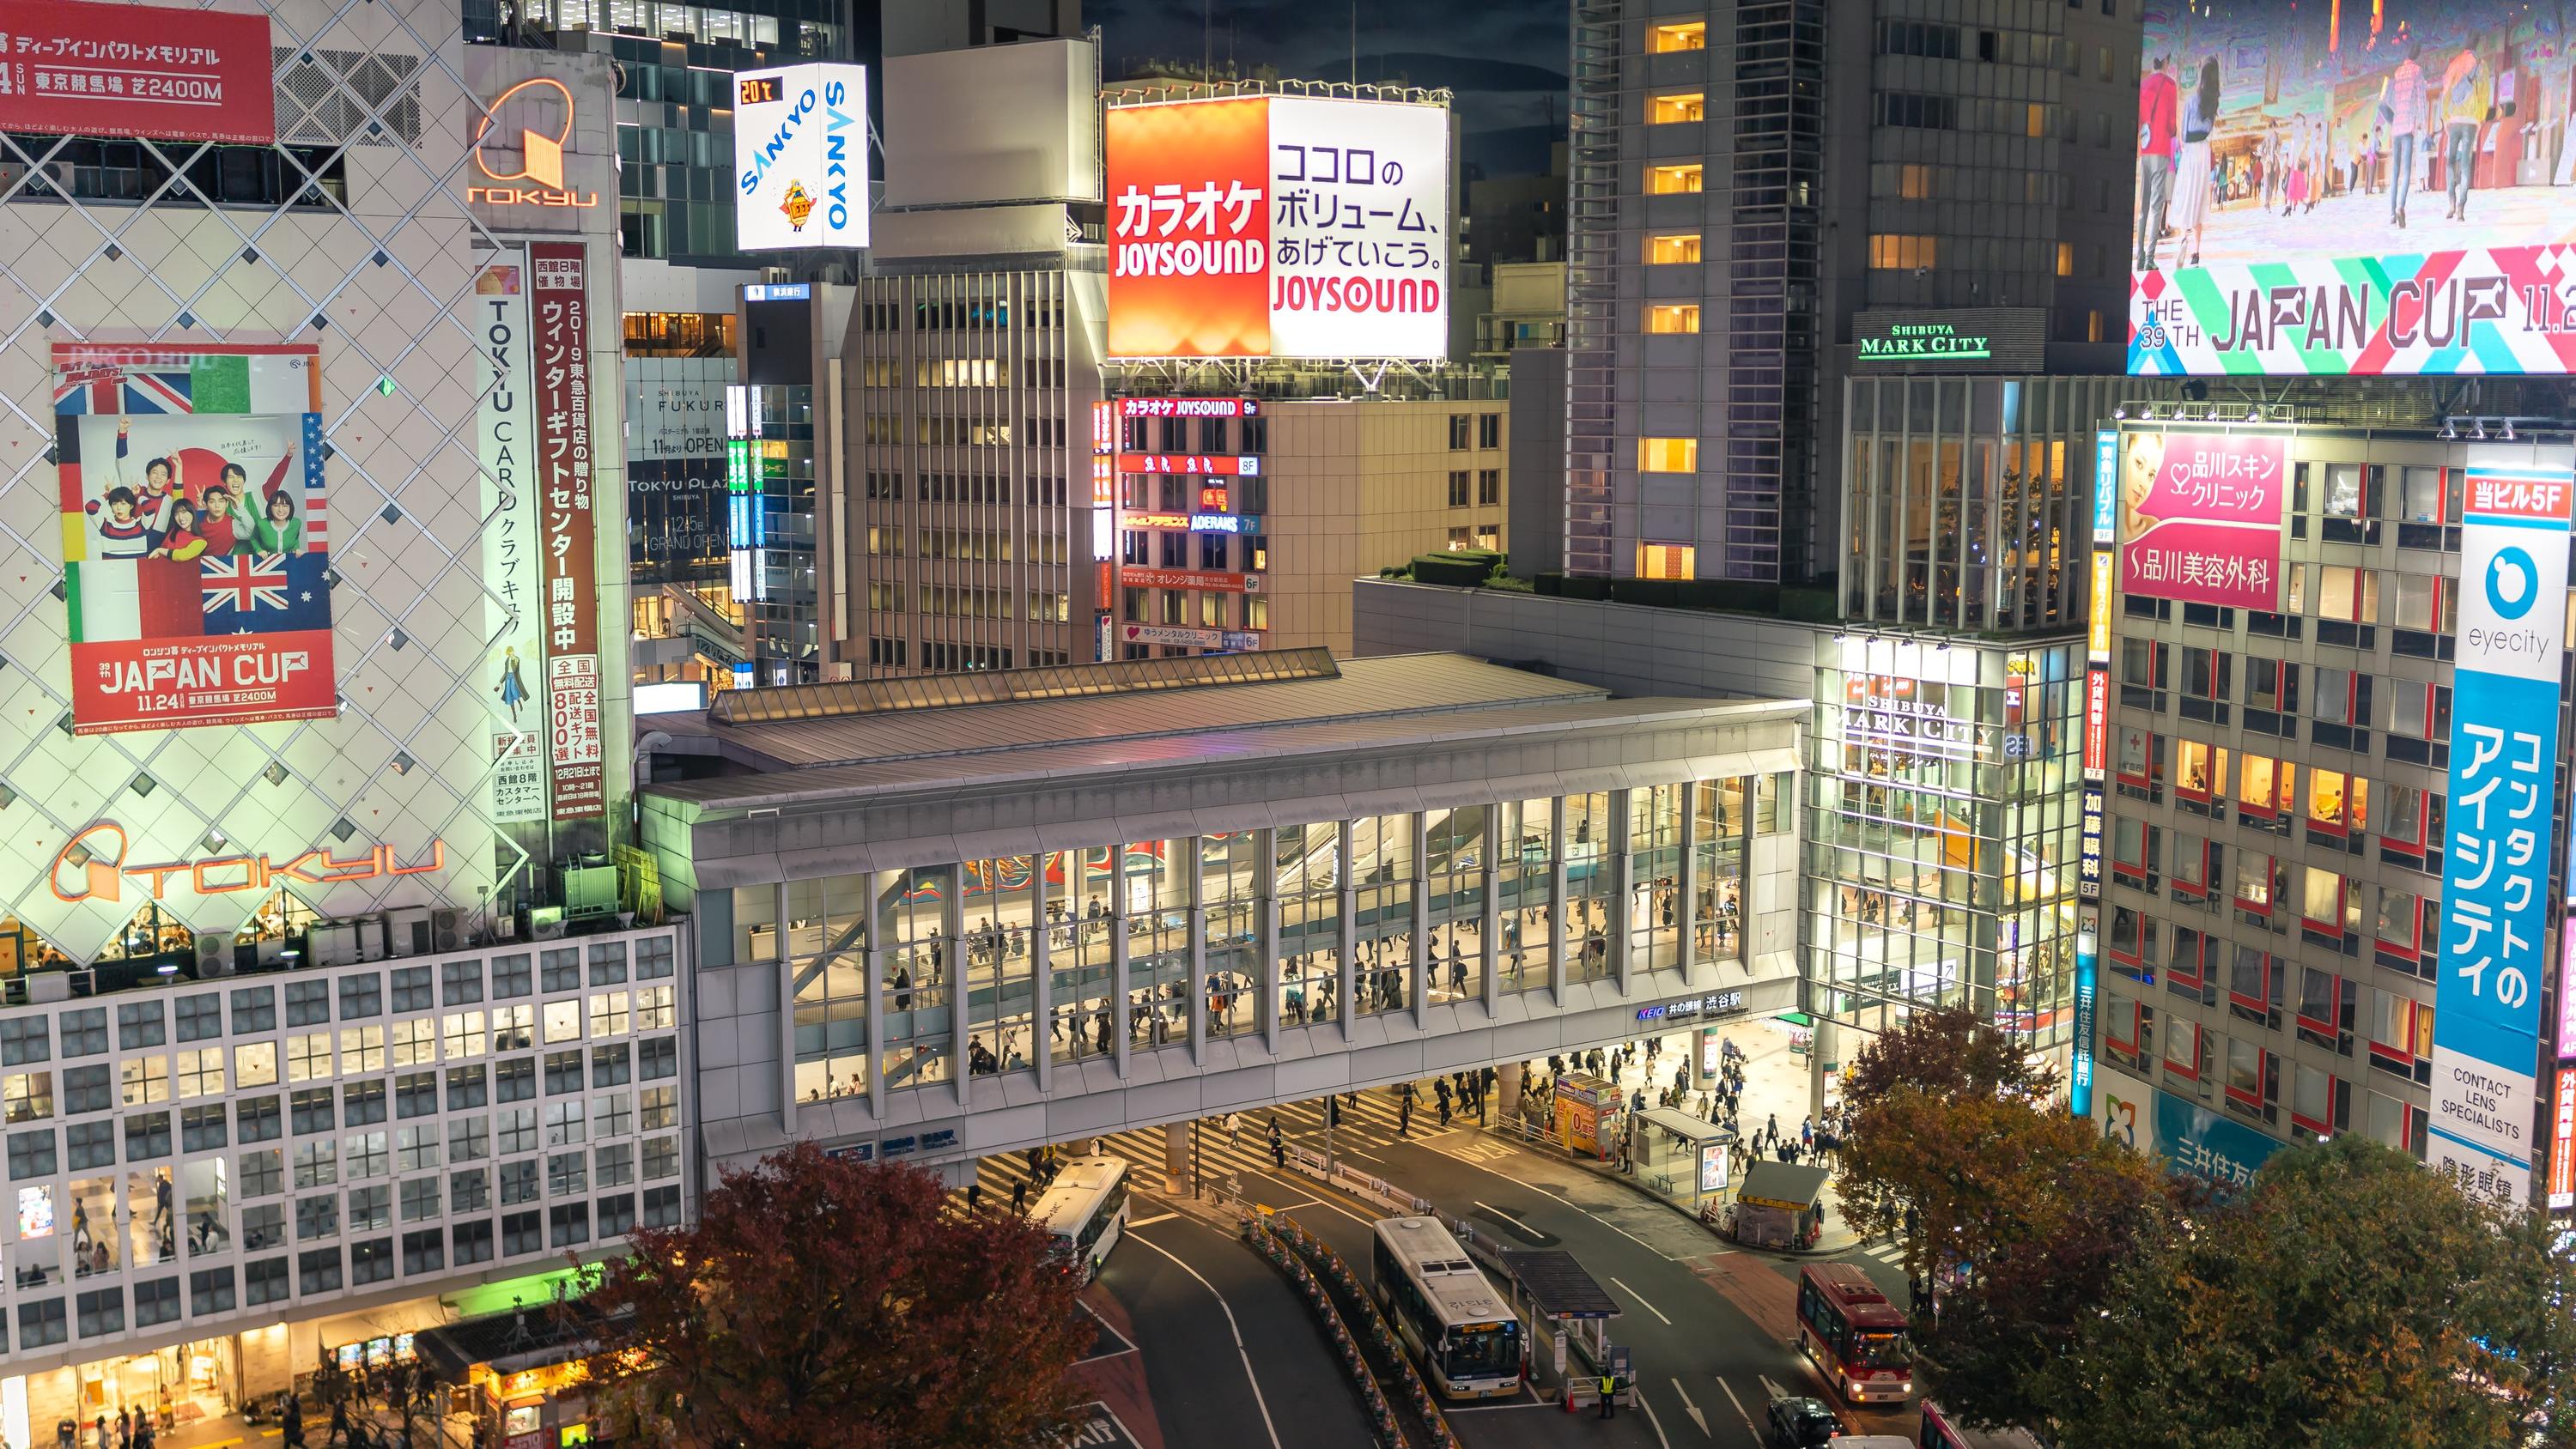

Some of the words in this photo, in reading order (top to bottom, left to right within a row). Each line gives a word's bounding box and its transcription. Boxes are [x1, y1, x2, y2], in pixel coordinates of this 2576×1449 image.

[35, 72, 124, 94] 東京競馬場
[740, 88, 817, 196] SANKYO
[825, 81, 855, 230] SANKYO
[1277, 144, 1403, 185] ココロの
[468, 187, 598, 208] TOKYU
[1115, 179, 1262, 239] カラオケ
[1115, 239, 1266, 277] JOYSOUND
[1276, 234, 1440, 270] あげていこう。
[1273, 275, 1440, 313] JOYSOUND
[2142, 300, 2184, 322] THE
[2212, 282, 2368, 352] JAPAN
[2387, 275, 2508, 349] CUP
[1861, 338, 1925, 354] MARK
[1931, 336, 1988, 352] CITY
[1892, 325, 1954, 336] SHIBUYA
[1125, 400, 1174, 415] カラオケ
[1176, 400, 1236, 416] JOYSOUND
[687, 438, 724, 454] OPEN
[1242, 460, 1255, 471] 8F
[2192, 451, 2276, 480] 品川スキン
[629, 481, 683, 492] TOKYU
[2191, 482, 2265, 511] クリニック
[2474, 481, 2562, 512] 当ビル5F
[1190, 515, 1238, 532] ADERANS
[650, 535, 691, 551] GRAND
[1246, 578, 1258, 590] 6F
[2142, 549, 2270, 594] 品川美容外科
[2469, 627, 2549, 663] eyecity
[100, 656, 222, 694] JAPAN
[234, 652, 309, 686] CUP
[558, 660, 591, 675] 全国
[137, 693, 179, 712] 11.24
[1868, 695, 1946, 717] SHIBUYA
[1923, 719, 1994, 746] CITY
[2082, 792, 2102, 878] 加藤眼科
[122, 839, 445, 900] TOKYU
[2451, 722, 2505, 997] アイシティ
[2496, 731, 2542, 1009] コンタクトの
[2082, 883, 2098, 894] 5F
[1638, 1007, 1664, 1020] KEIO
[1668, 1000, 1702, 1015] 井の頭線
[1705, 992, 1741, 1010] 渋谷駅
[2453, 1068, 2512, 1099] CONTACT
[2465, 1089, 2496, 1113] LENS
[2441, 1099, 2520, 1140] SPECIALISTS
